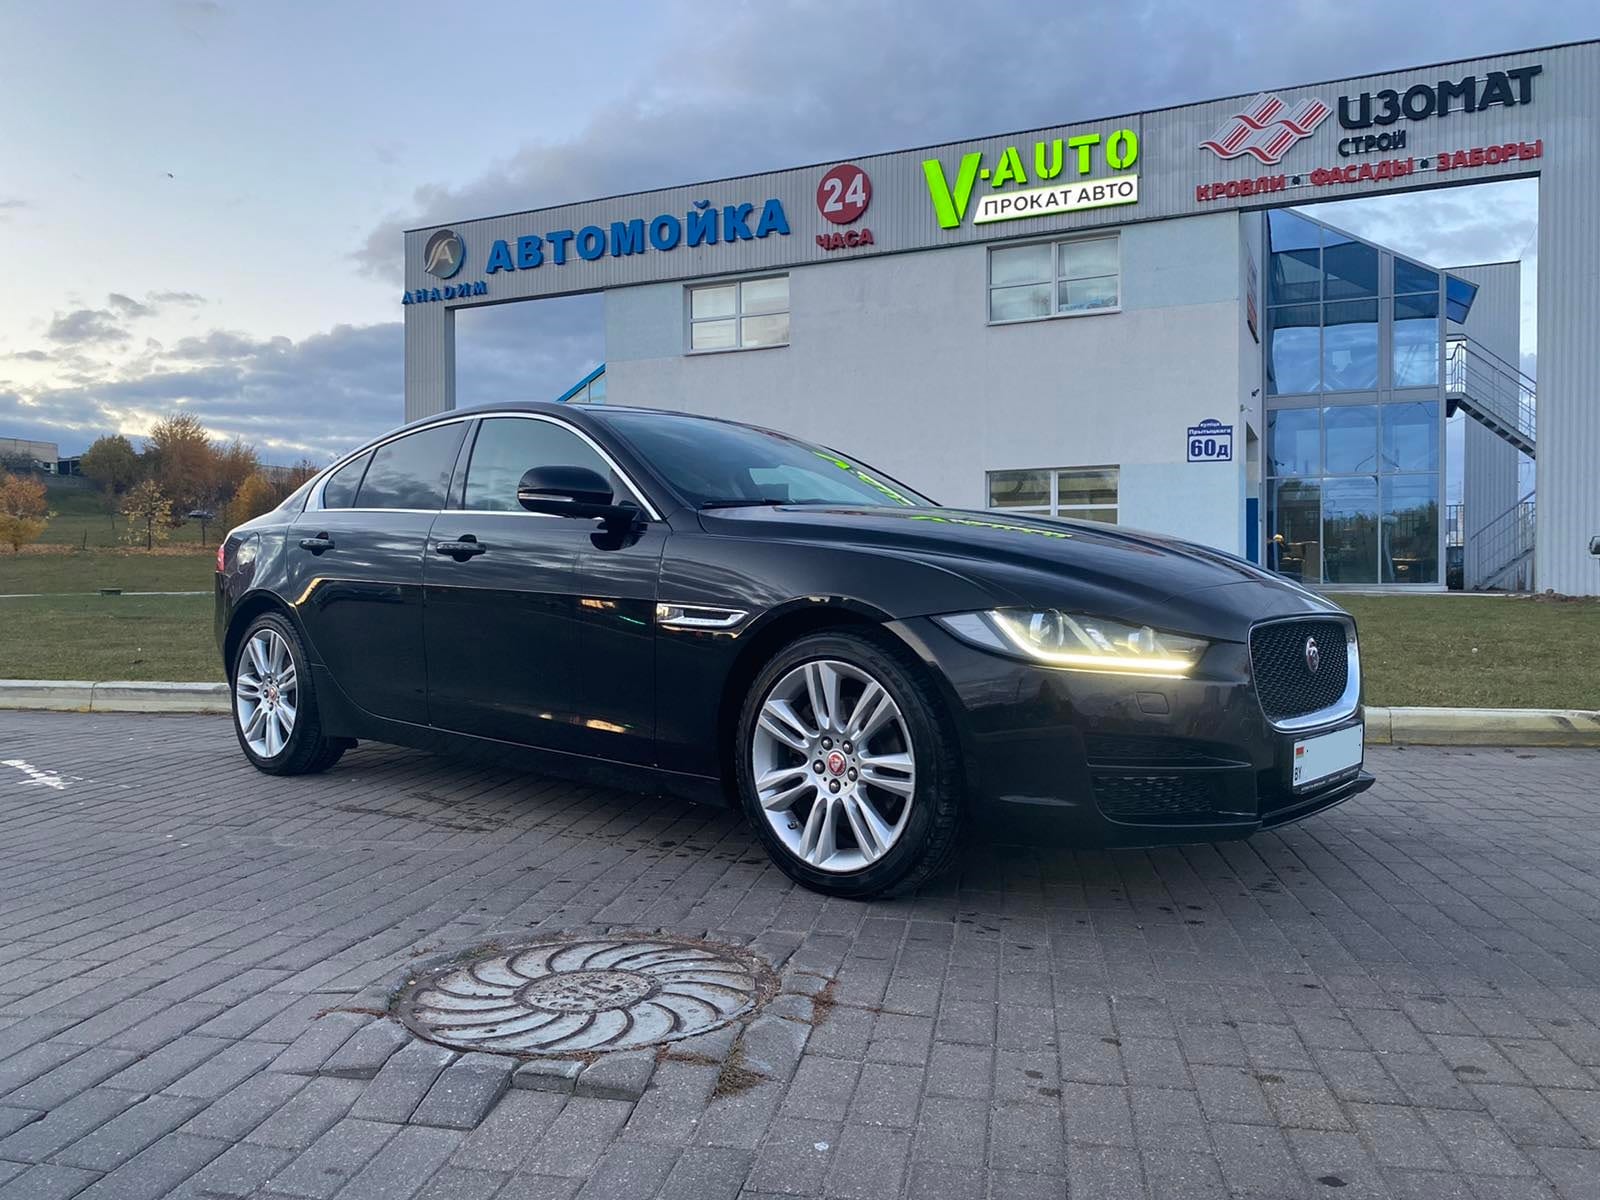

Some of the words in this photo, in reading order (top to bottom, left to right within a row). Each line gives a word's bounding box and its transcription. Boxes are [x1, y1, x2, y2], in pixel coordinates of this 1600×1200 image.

[1338, 129, 1406, 157] СТРОЙ
[1196, 174, 1285, 202] КРОВЛИ
[1310, 157, 1413, 186] ФАСАДЫ
[1437, 139, 1543, 172] ЗАБОРЫ
[823, 173, 866, 213] 24
[985, 189, 1072, 216] ПРОКАТ
[1076, 181, 1134, 204] АВТО
[485, 199, 791, 274] АВТОМОЙКА
[815, 228, 874, 251] ЧАСА
